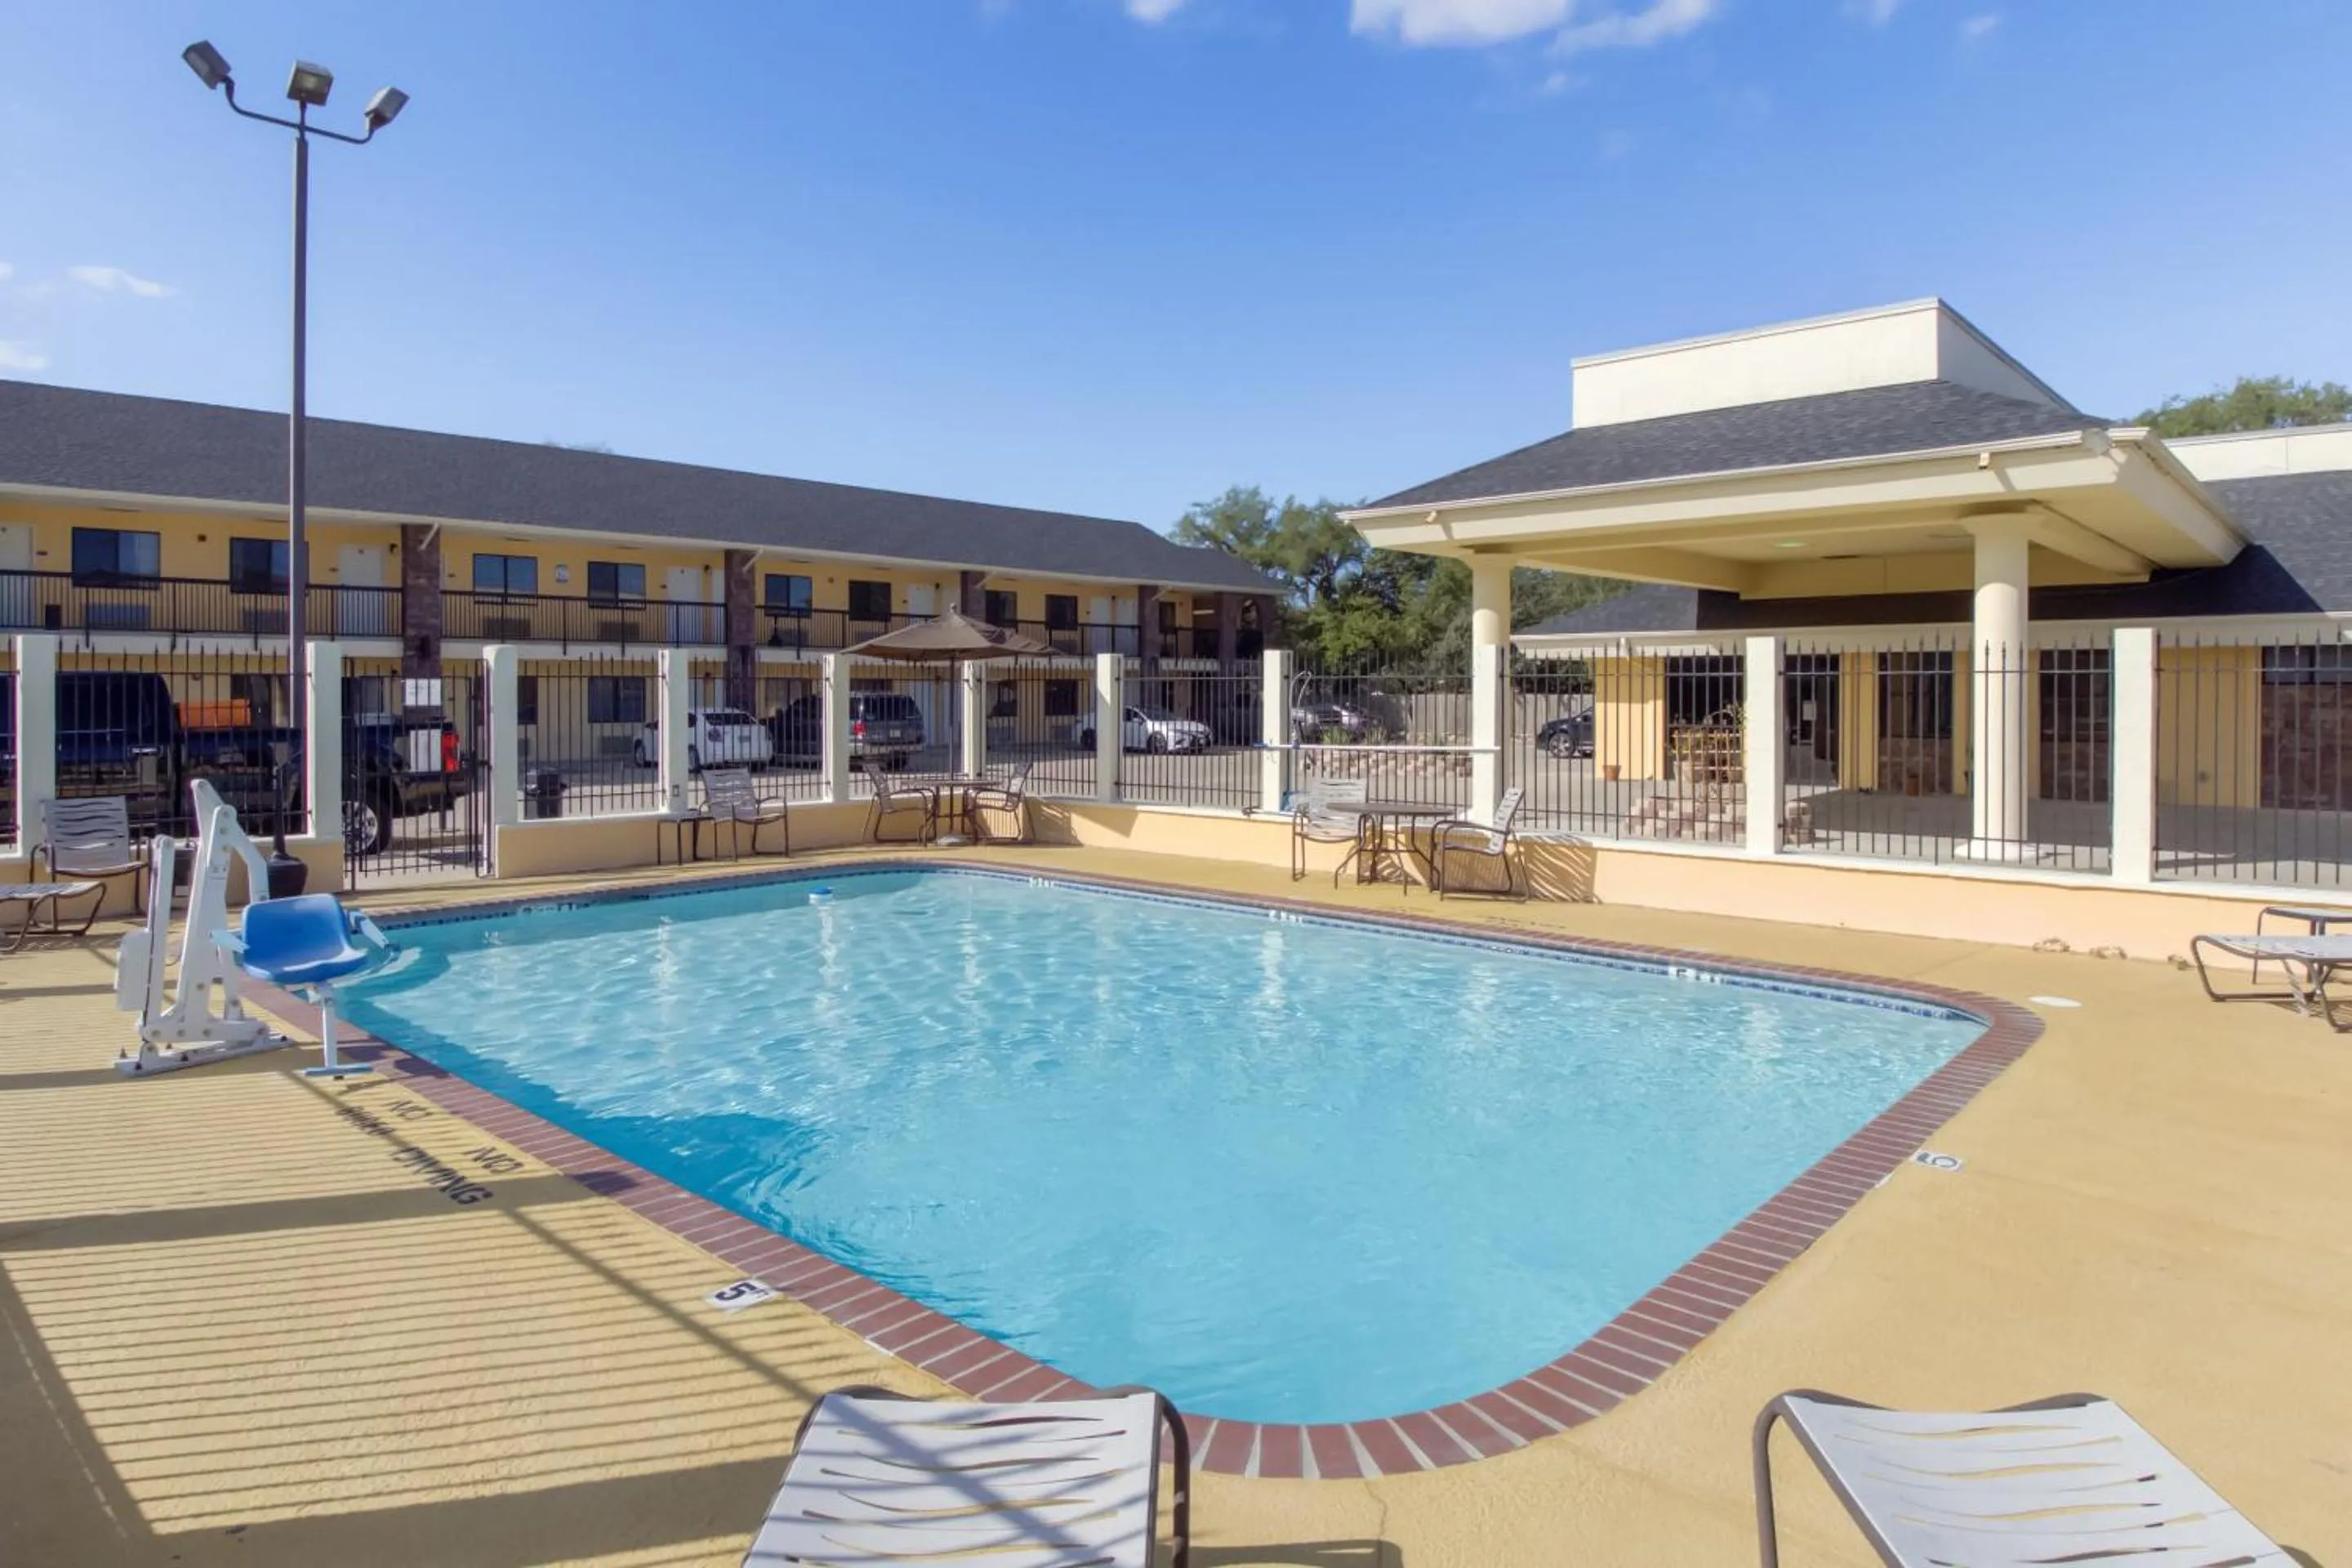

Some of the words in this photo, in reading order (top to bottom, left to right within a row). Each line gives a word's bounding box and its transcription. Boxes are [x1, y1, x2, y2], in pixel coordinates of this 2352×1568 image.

[462, 1147, 524, 1173] NO
[390, 1147, 493, 1205] DIVING
[715, 1282, 757, 1301] 5
